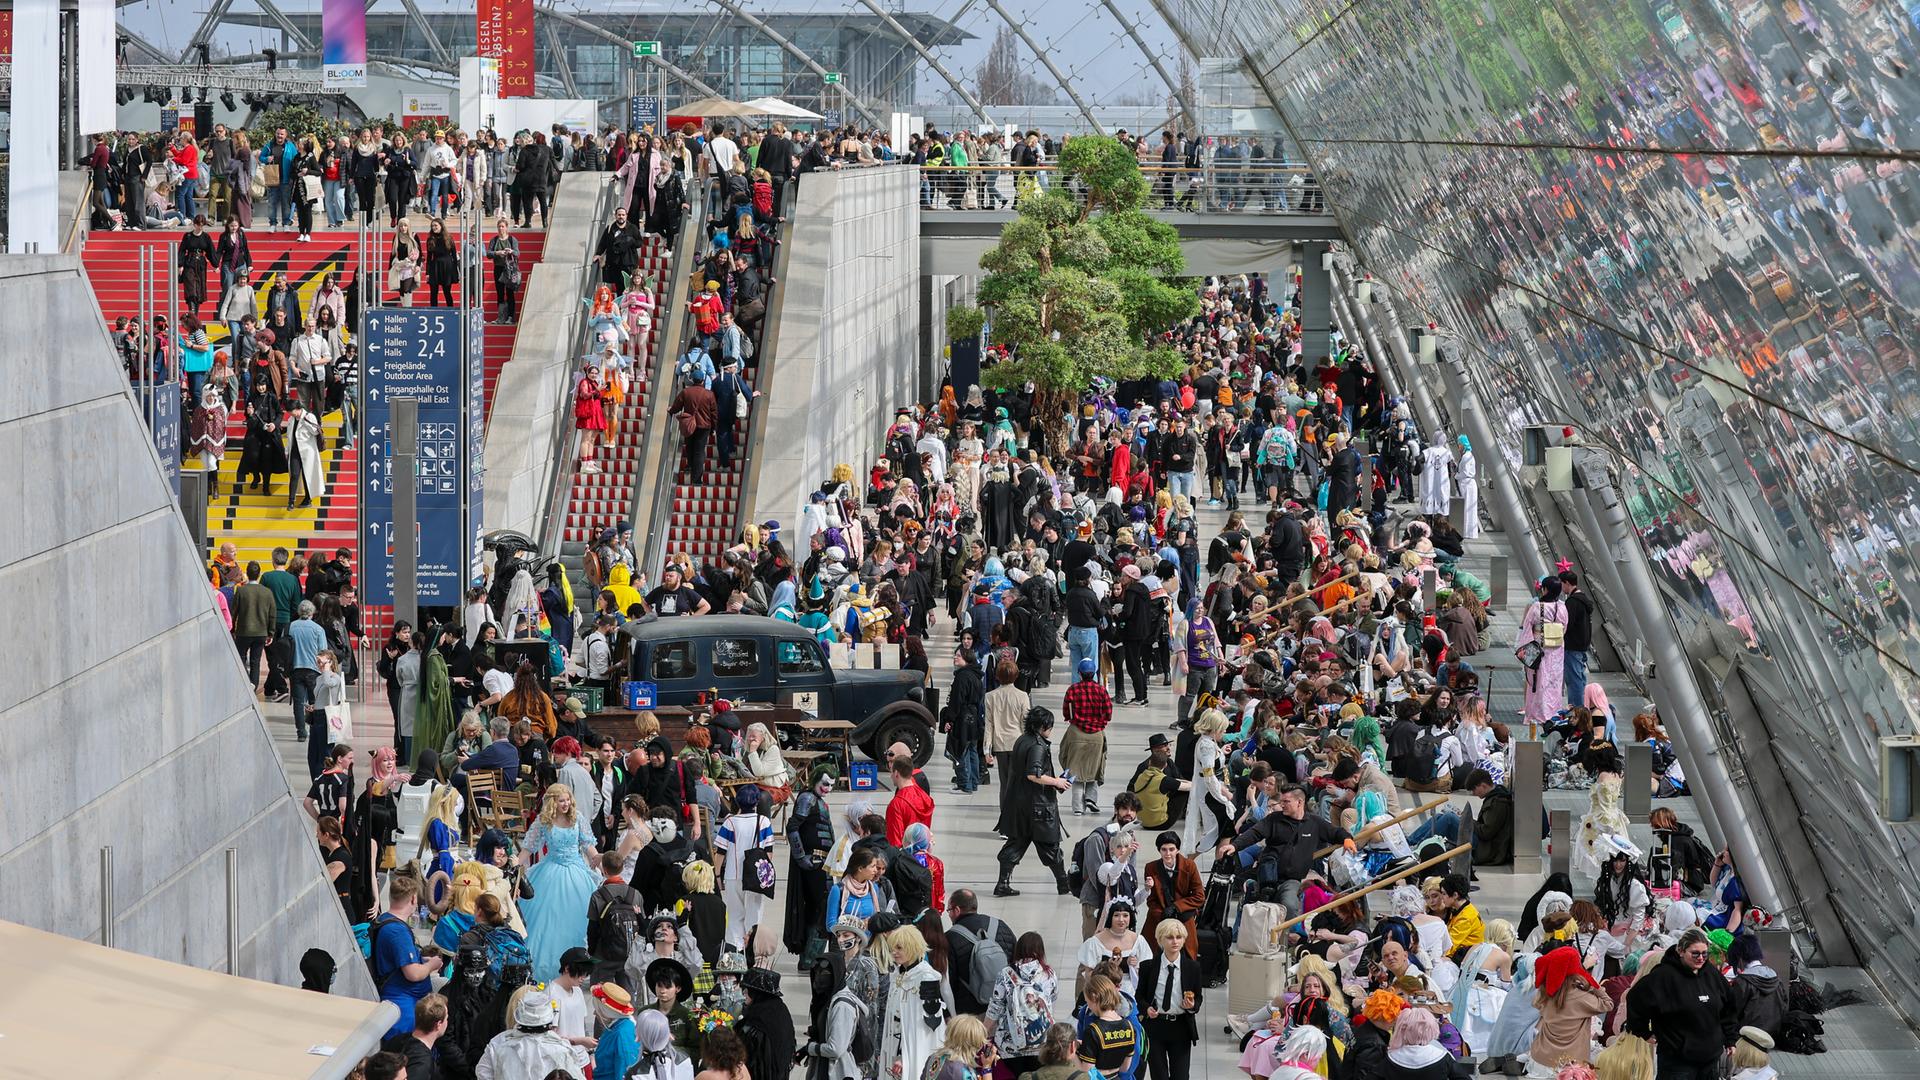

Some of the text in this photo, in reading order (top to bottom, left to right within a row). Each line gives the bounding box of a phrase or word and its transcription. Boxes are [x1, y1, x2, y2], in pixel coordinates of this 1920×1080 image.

[3, 13, 9, 22] 2
[507, 12, 513, 20] 2
[3, 29, 9, 38] 3
[507, 28, 513, 36] 3
[507, 61, 513, 69] 5
[507, 76, 529, 86] CCL
[384, 315, 445, 337] Hallen 3,5
[384, 325, 402, 334] Halls
[384, 338, 446, 360] Hallen 2,4
[384, 348, 402, 357] Halls
[384, 361, 426, 371] Freigelände
[384, 372, 433, 380] Outdoor Area
[384, 385, 449, 395] Eingangshalle Ost
[417, 395, 450, 404] Hall East
[319, 783, 337, 811] 11
